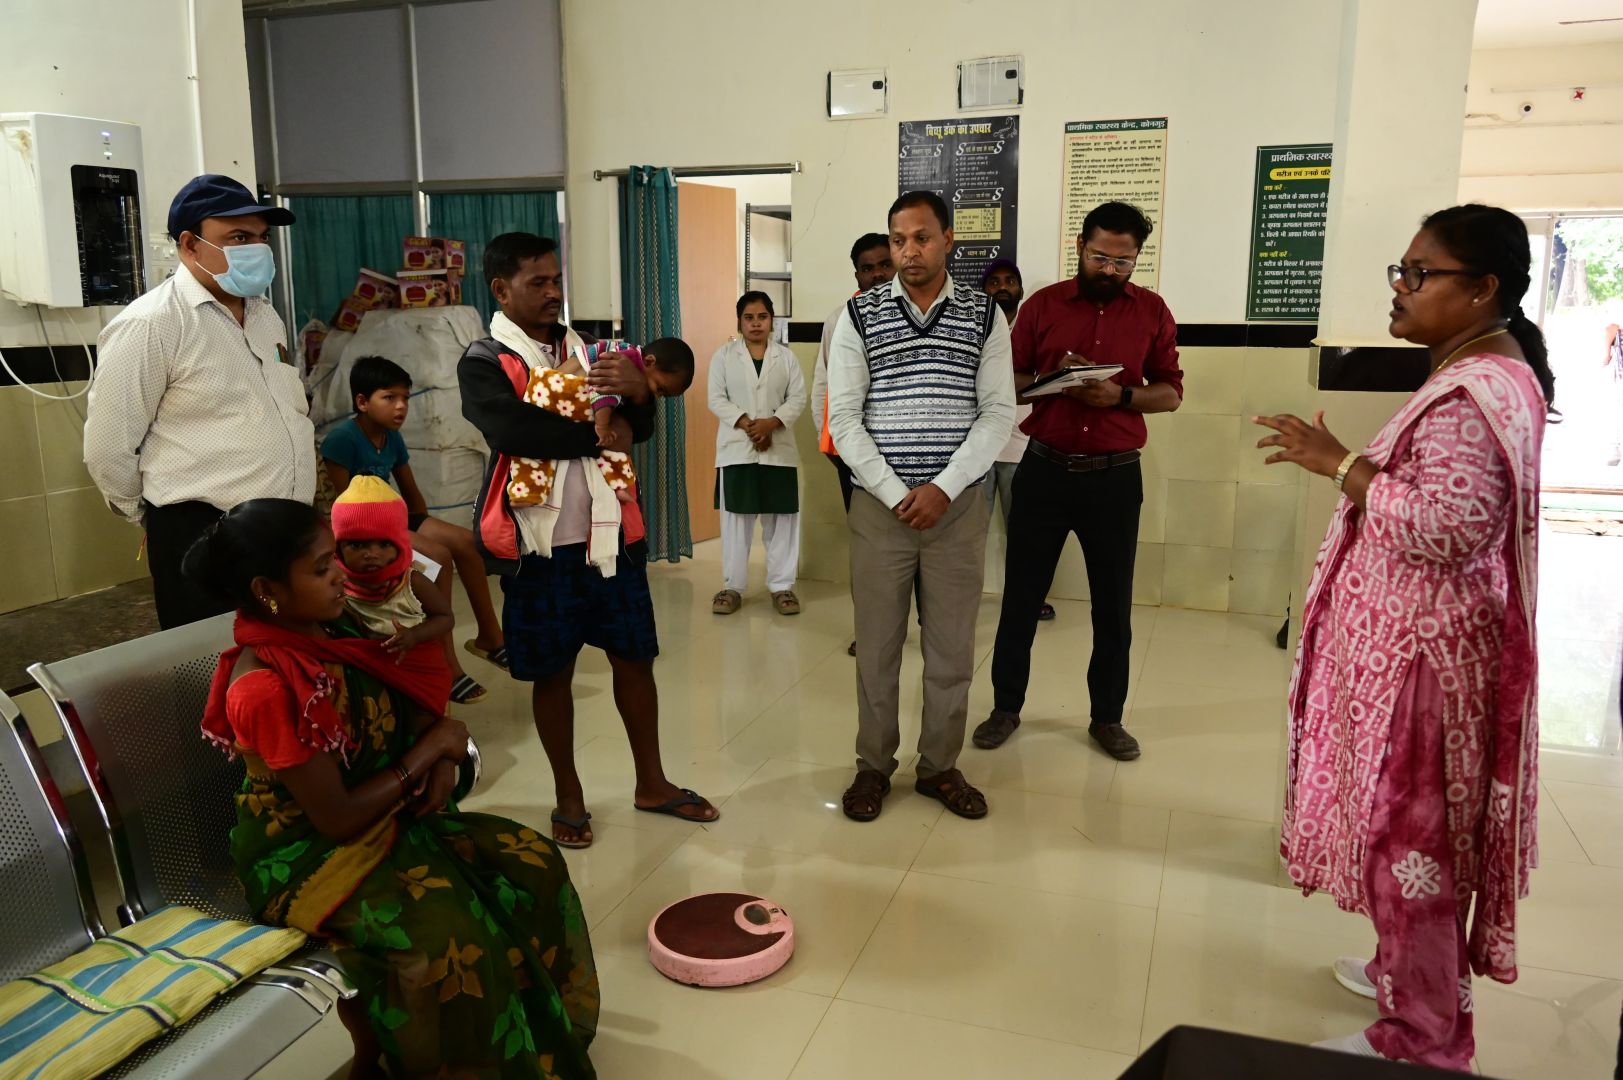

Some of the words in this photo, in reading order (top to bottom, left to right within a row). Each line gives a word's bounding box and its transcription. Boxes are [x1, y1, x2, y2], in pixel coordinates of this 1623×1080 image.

[944, 123, 956, 135] डंक
[957, 124, 967, 134] का
[968, 123, 992, 134] उपचार
[1271, 152, 1304, 162] प्राथमिक
